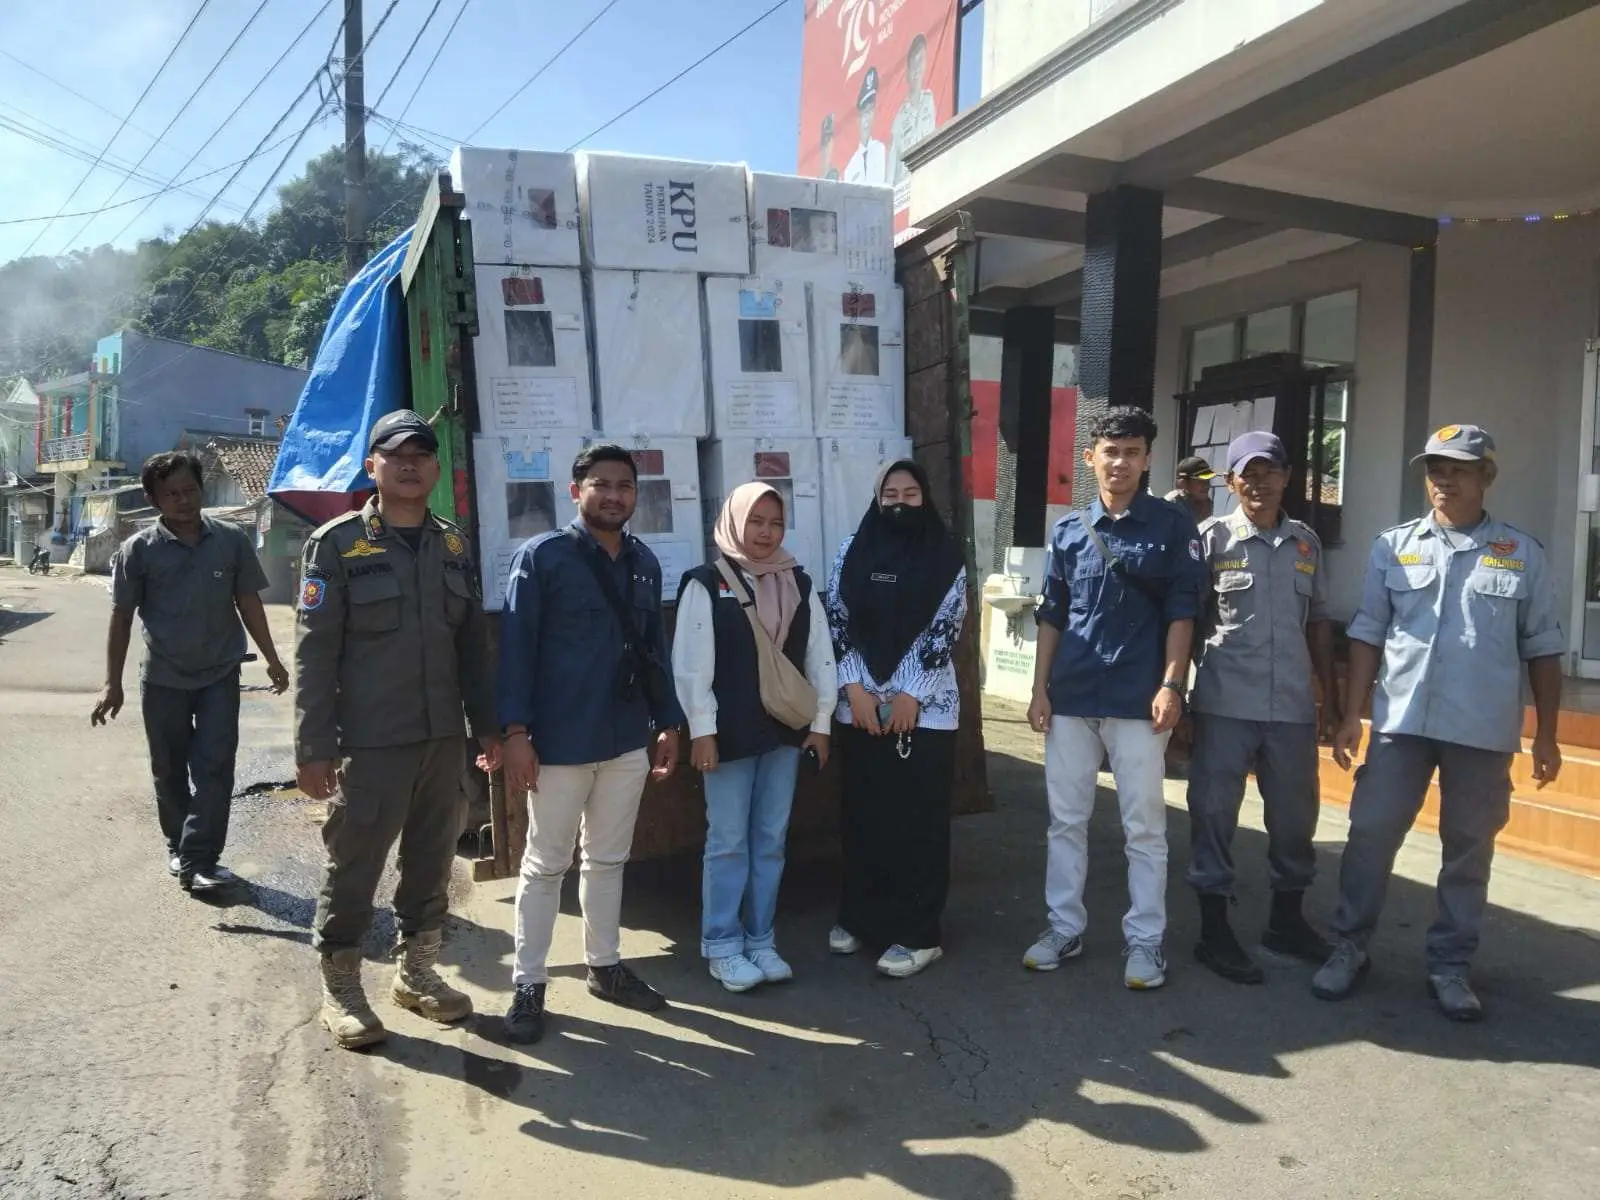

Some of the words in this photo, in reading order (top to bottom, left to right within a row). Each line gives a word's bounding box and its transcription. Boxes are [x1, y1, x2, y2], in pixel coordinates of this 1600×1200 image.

[643, 182, 655, 217] TAHUN
[669, 180, 698, 254] KPU
[646, 219, 656, 244] 2024
